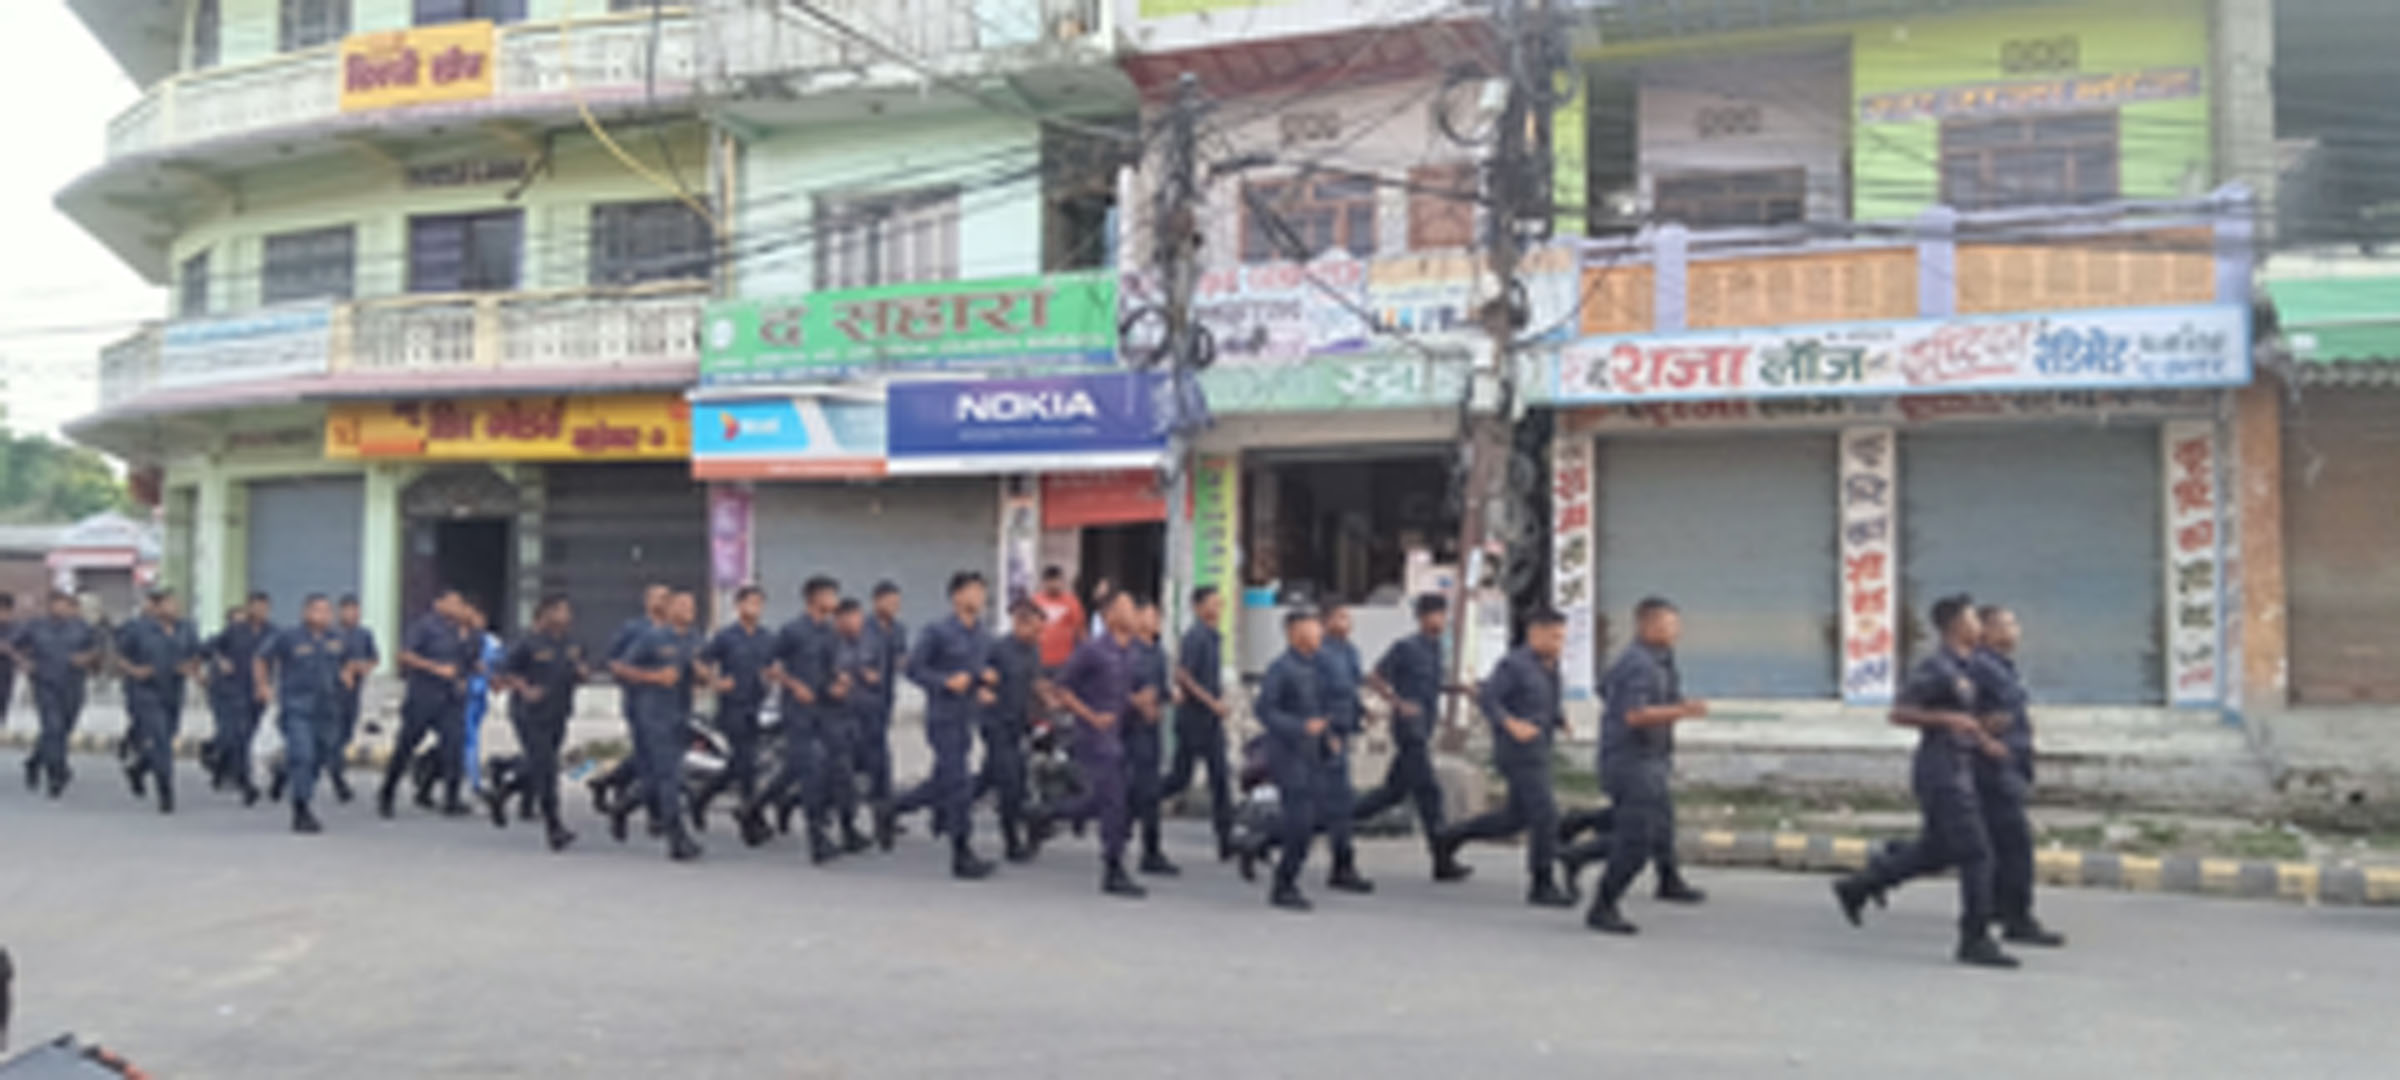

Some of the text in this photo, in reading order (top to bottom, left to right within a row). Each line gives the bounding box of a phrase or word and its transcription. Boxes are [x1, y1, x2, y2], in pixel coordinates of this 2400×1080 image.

[833, 287, 1057, 342] सहारा
[1611, 343, 1751, 392] राजा
[957, 391, 1097, 422] NOKIA
